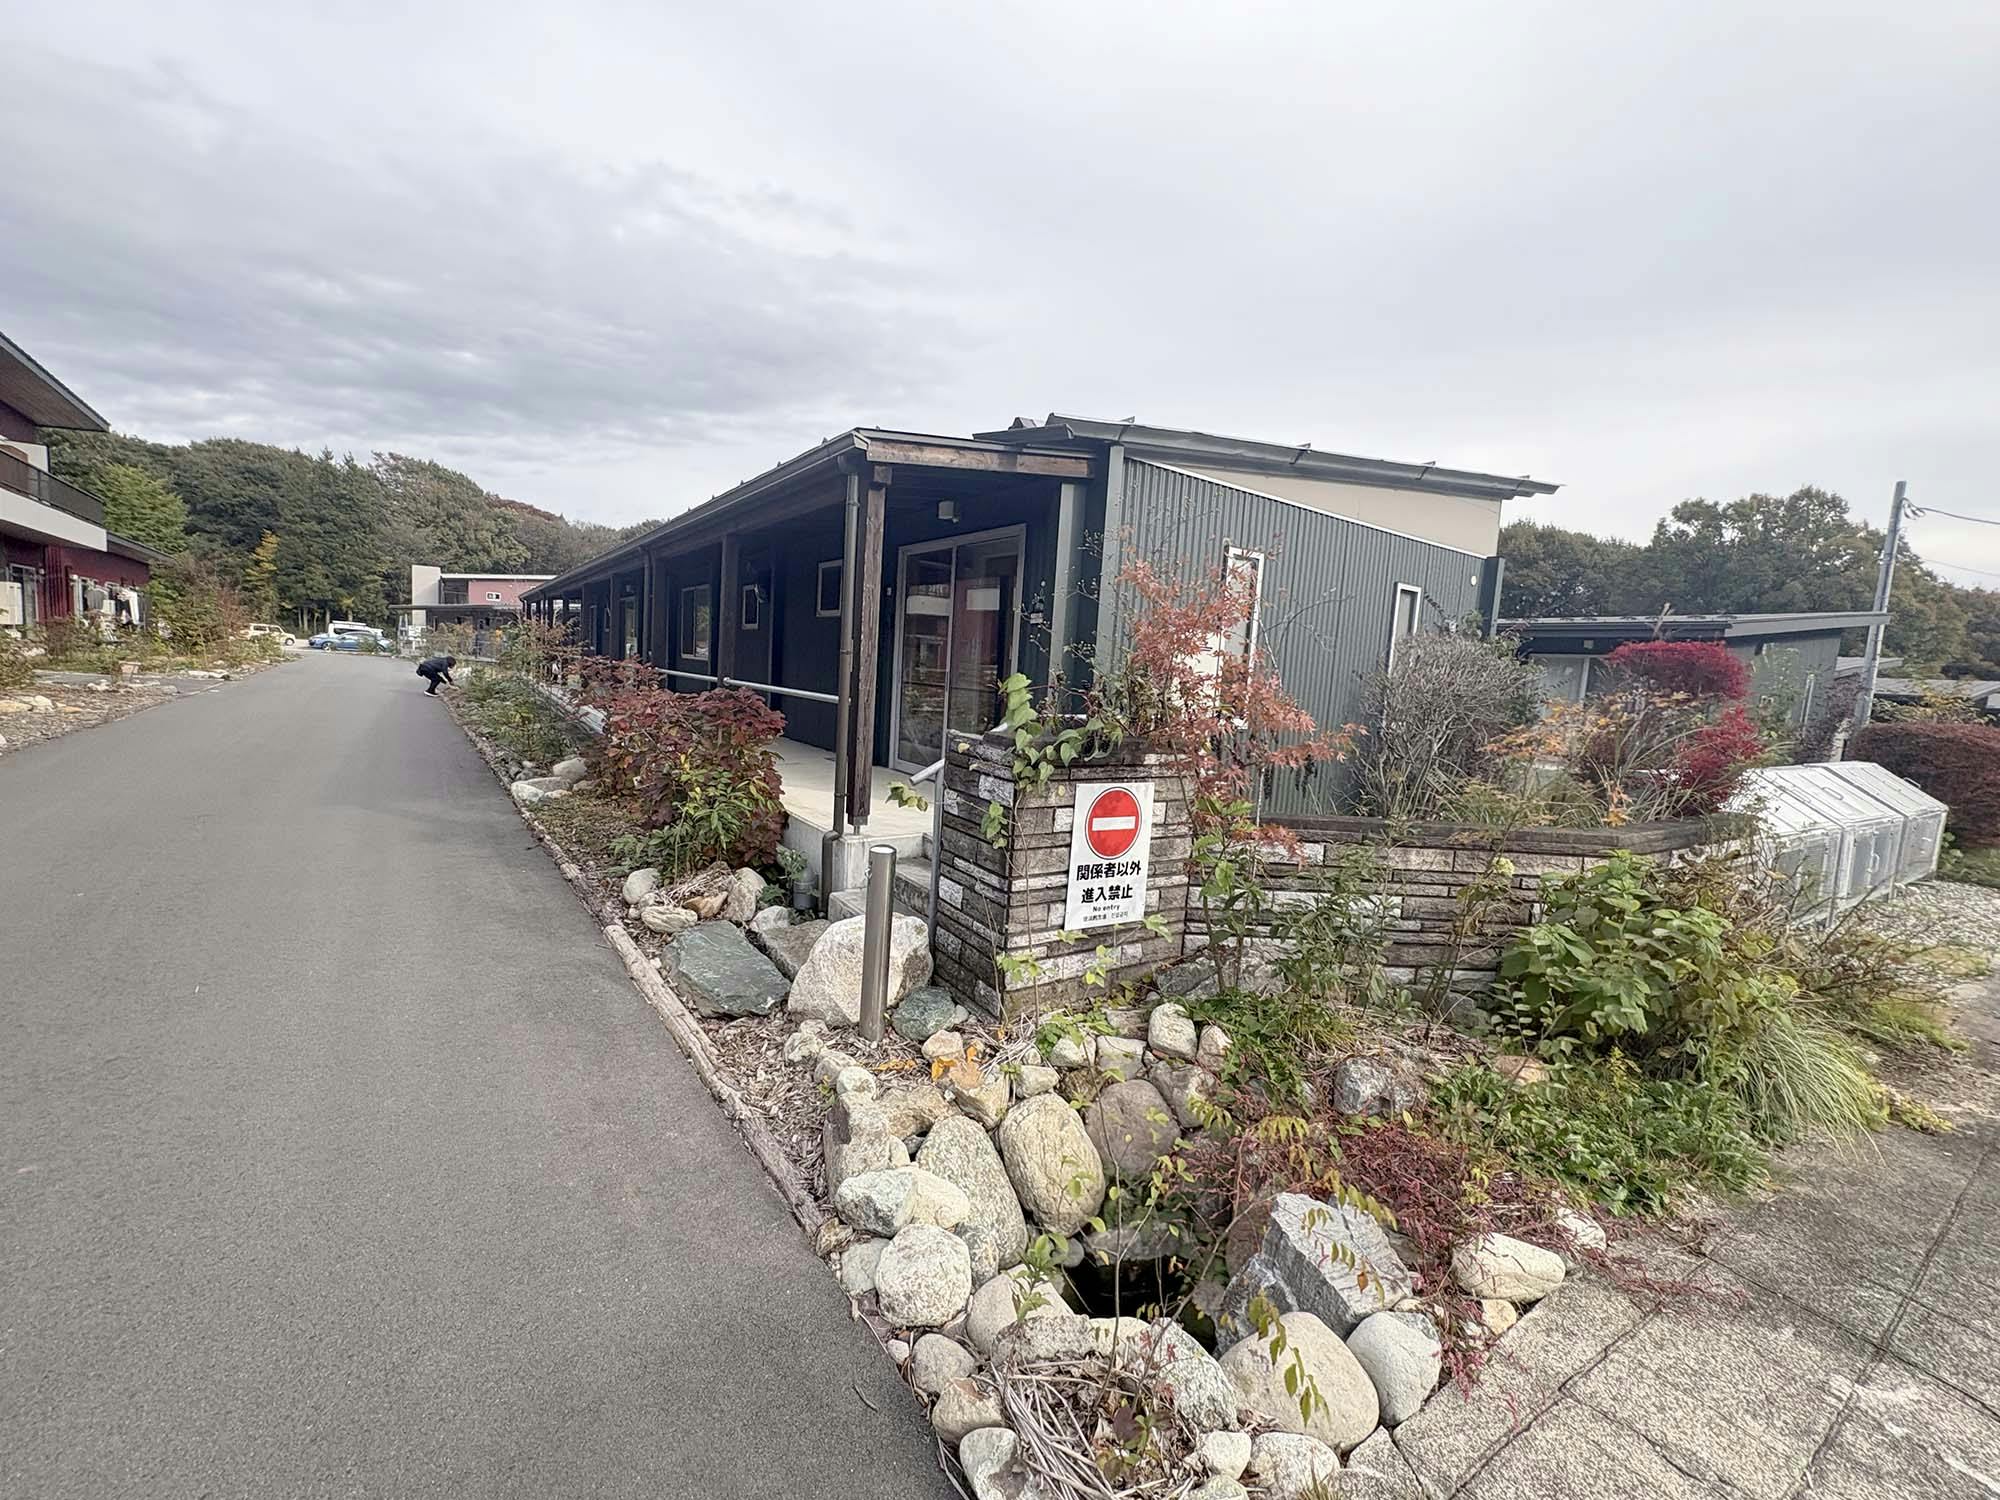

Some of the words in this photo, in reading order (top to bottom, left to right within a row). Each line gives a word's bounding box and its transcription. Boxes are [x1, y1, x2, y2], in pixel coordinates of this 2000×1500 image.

[1076, 860, 1141, 881] 関係者以外
[1081, 884, 1133, 903] 進入禁止
